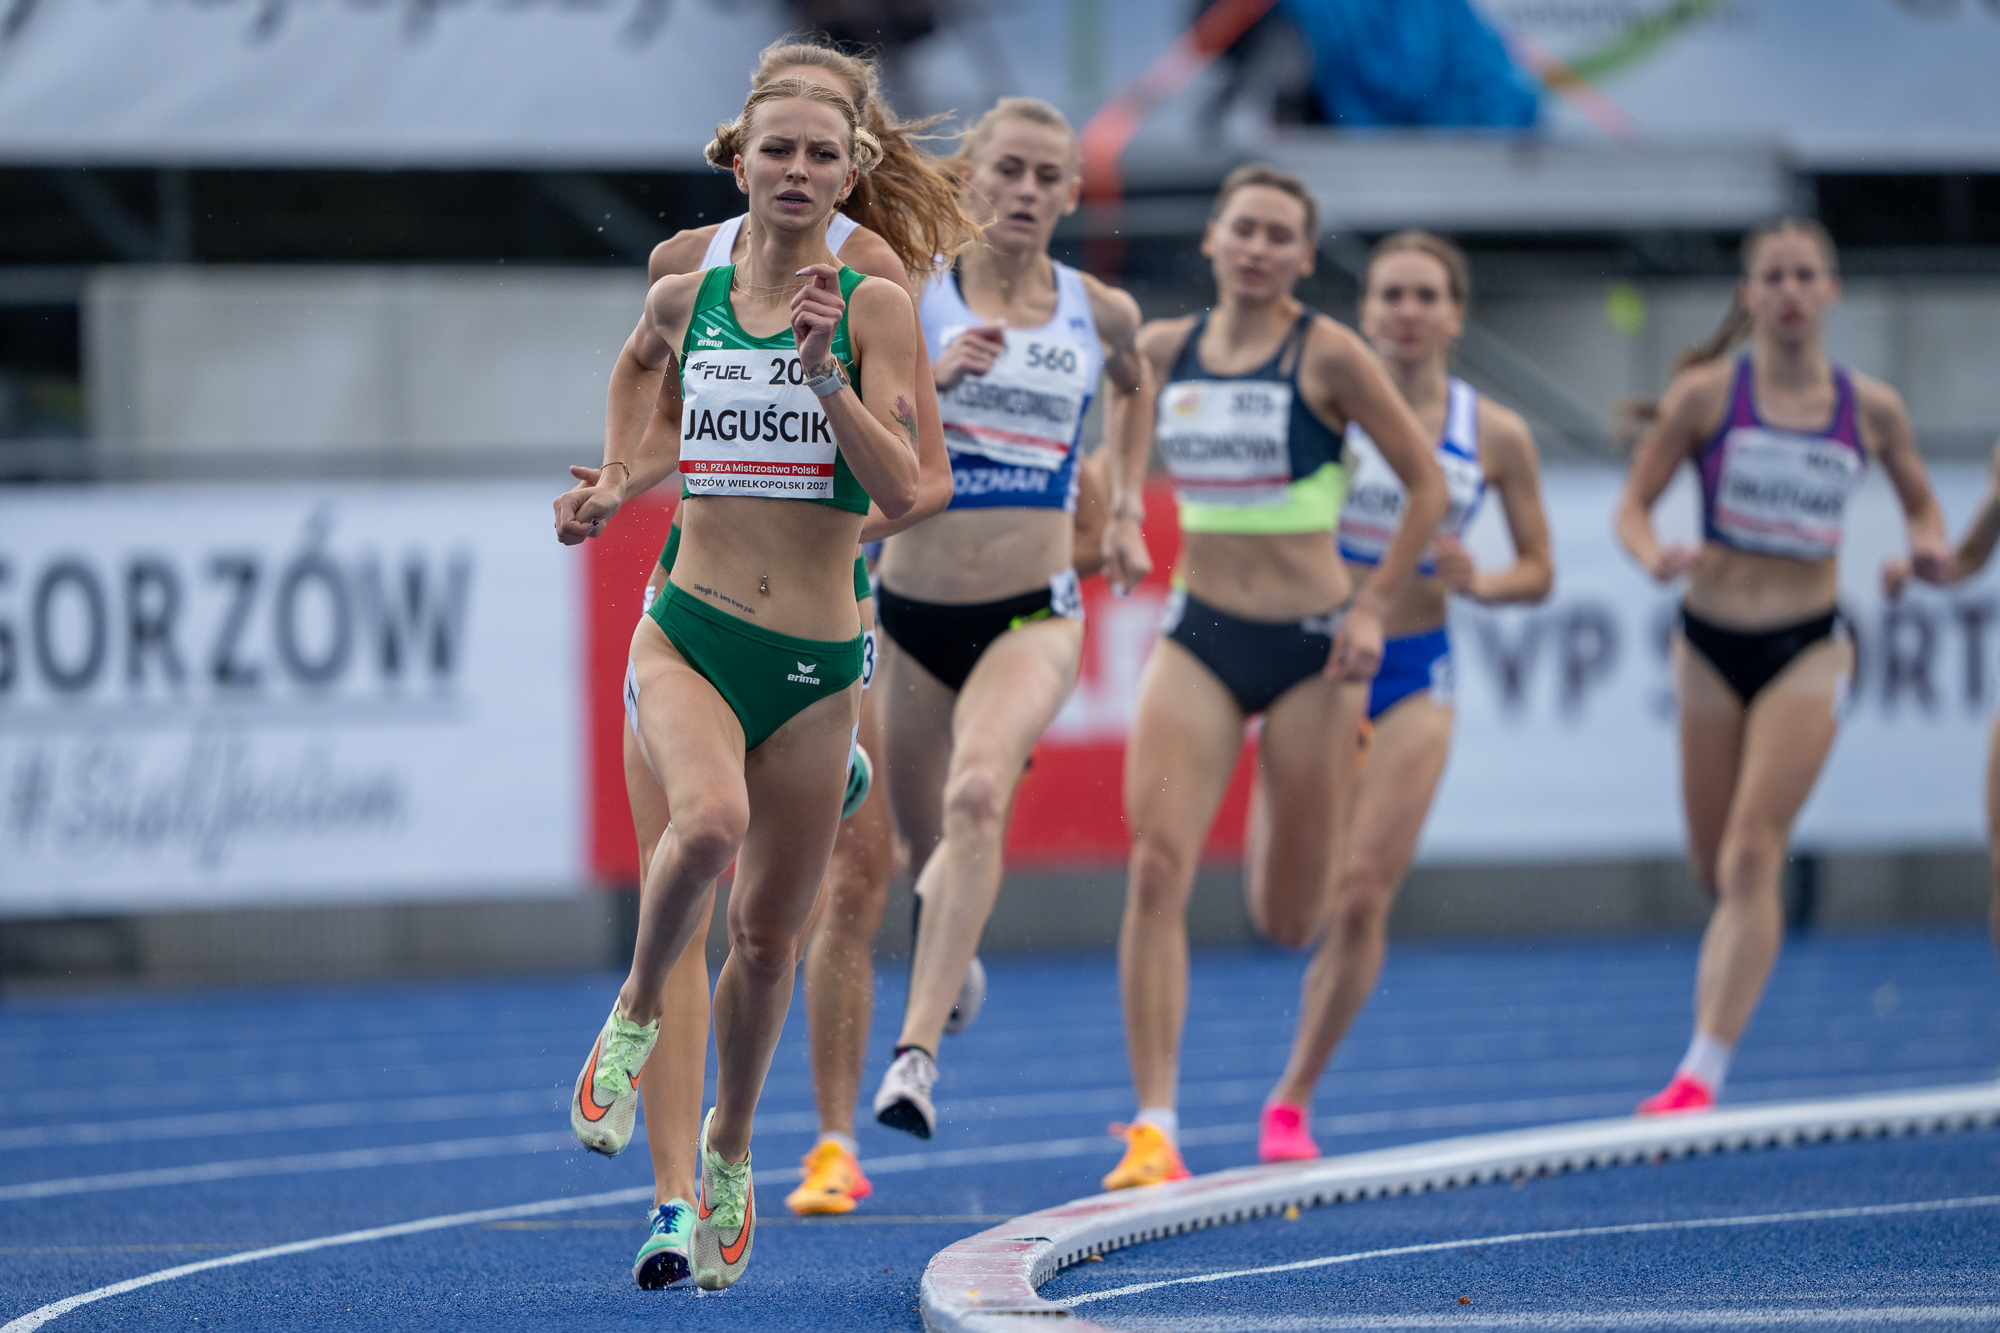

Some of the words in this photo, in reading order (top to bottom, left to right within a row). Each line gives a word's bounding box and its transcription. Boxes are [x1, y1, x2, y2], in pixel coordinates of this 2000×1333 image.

[697, 338, 723, 347] erima
[1025, 343, 1077, 373] 560
[704, 365, 752, 380] FUEL
[684, 404, 832, 443] JAGUŚCIK
[694, 462, 709, 472] 99.
[710, 463, 731, 472] PZLA
[732, 464, 790, 474] Mistrzostwa
[791, 465, 820, 475] Polski
[728, 479, 804, 490] WIELKOPOLSKI
[0, 503, 474, 693] ORZÓW
[787, 673, 820, 685] erima
